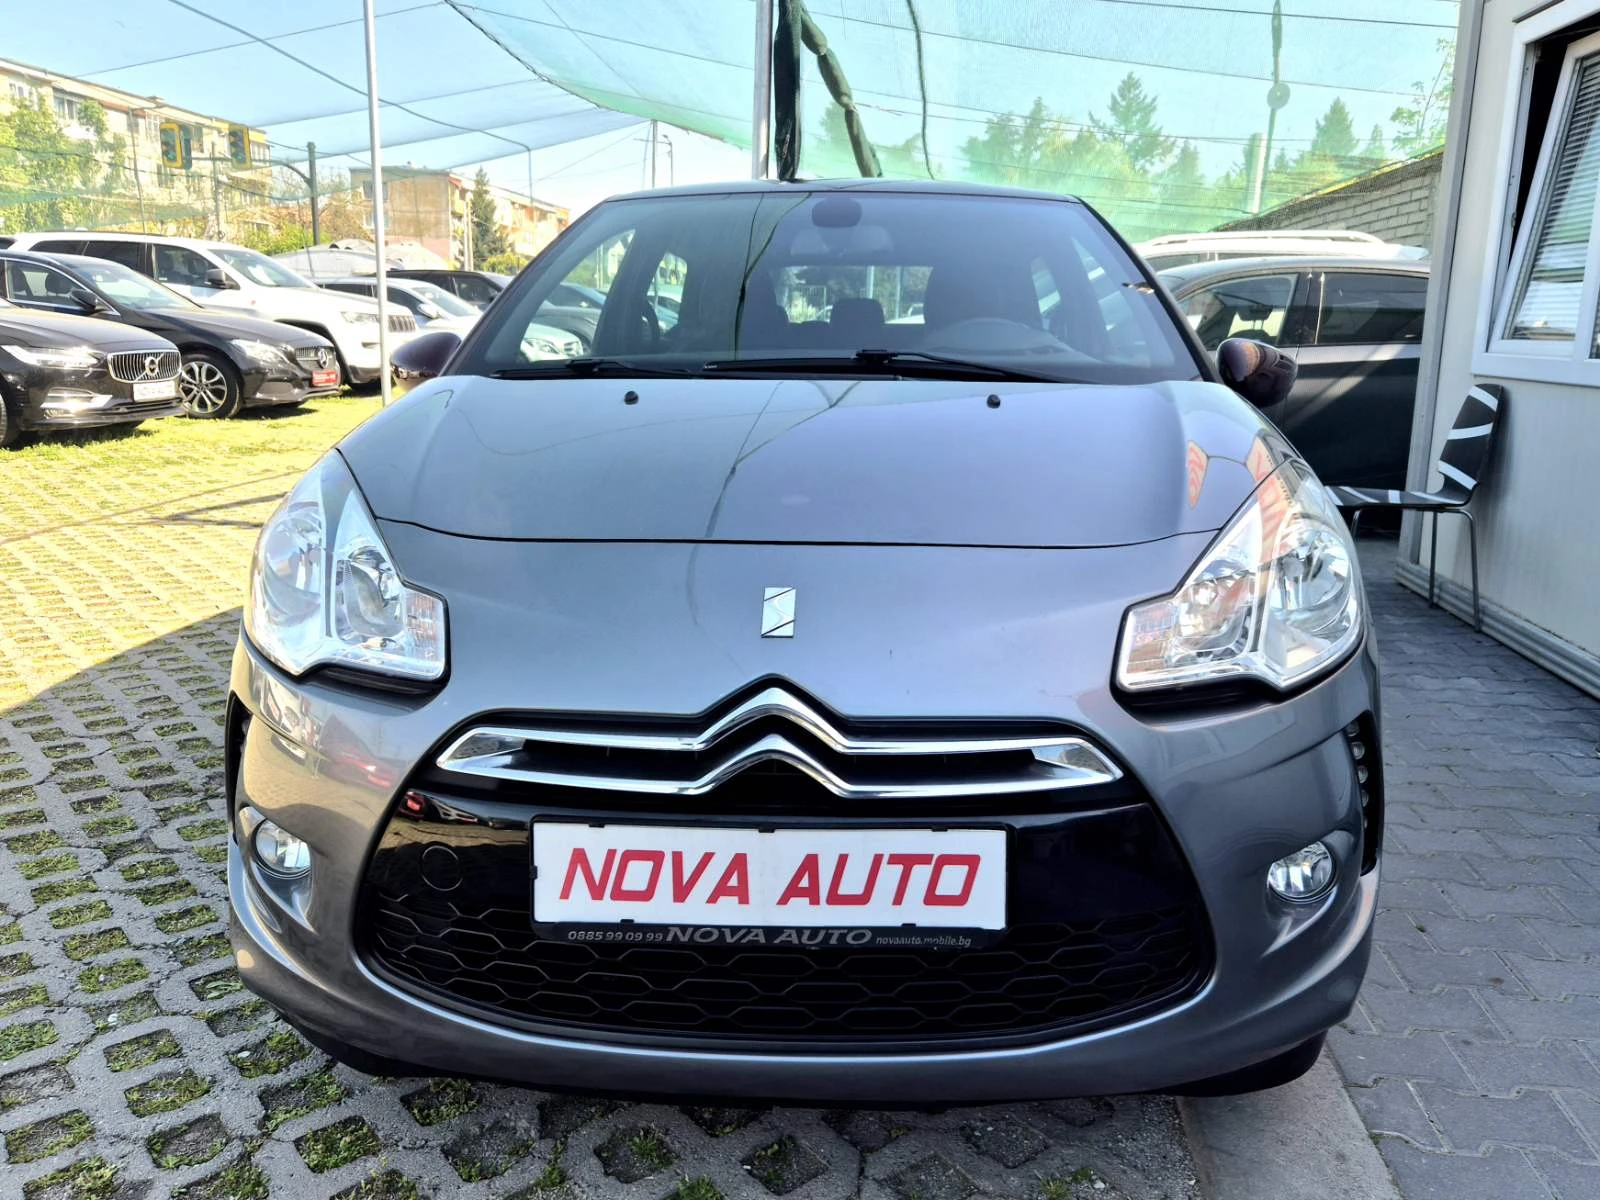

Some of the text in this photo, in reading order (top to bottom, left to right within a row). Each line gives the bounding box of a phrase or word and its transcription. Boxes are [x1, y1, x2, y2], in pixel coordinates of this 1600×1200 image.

[559, 847, 982, 907] NOVA AUTO
[567, 926, 972, 948] 0885 99 09 99 NOVA AUTO novaauto.mobile.bg
